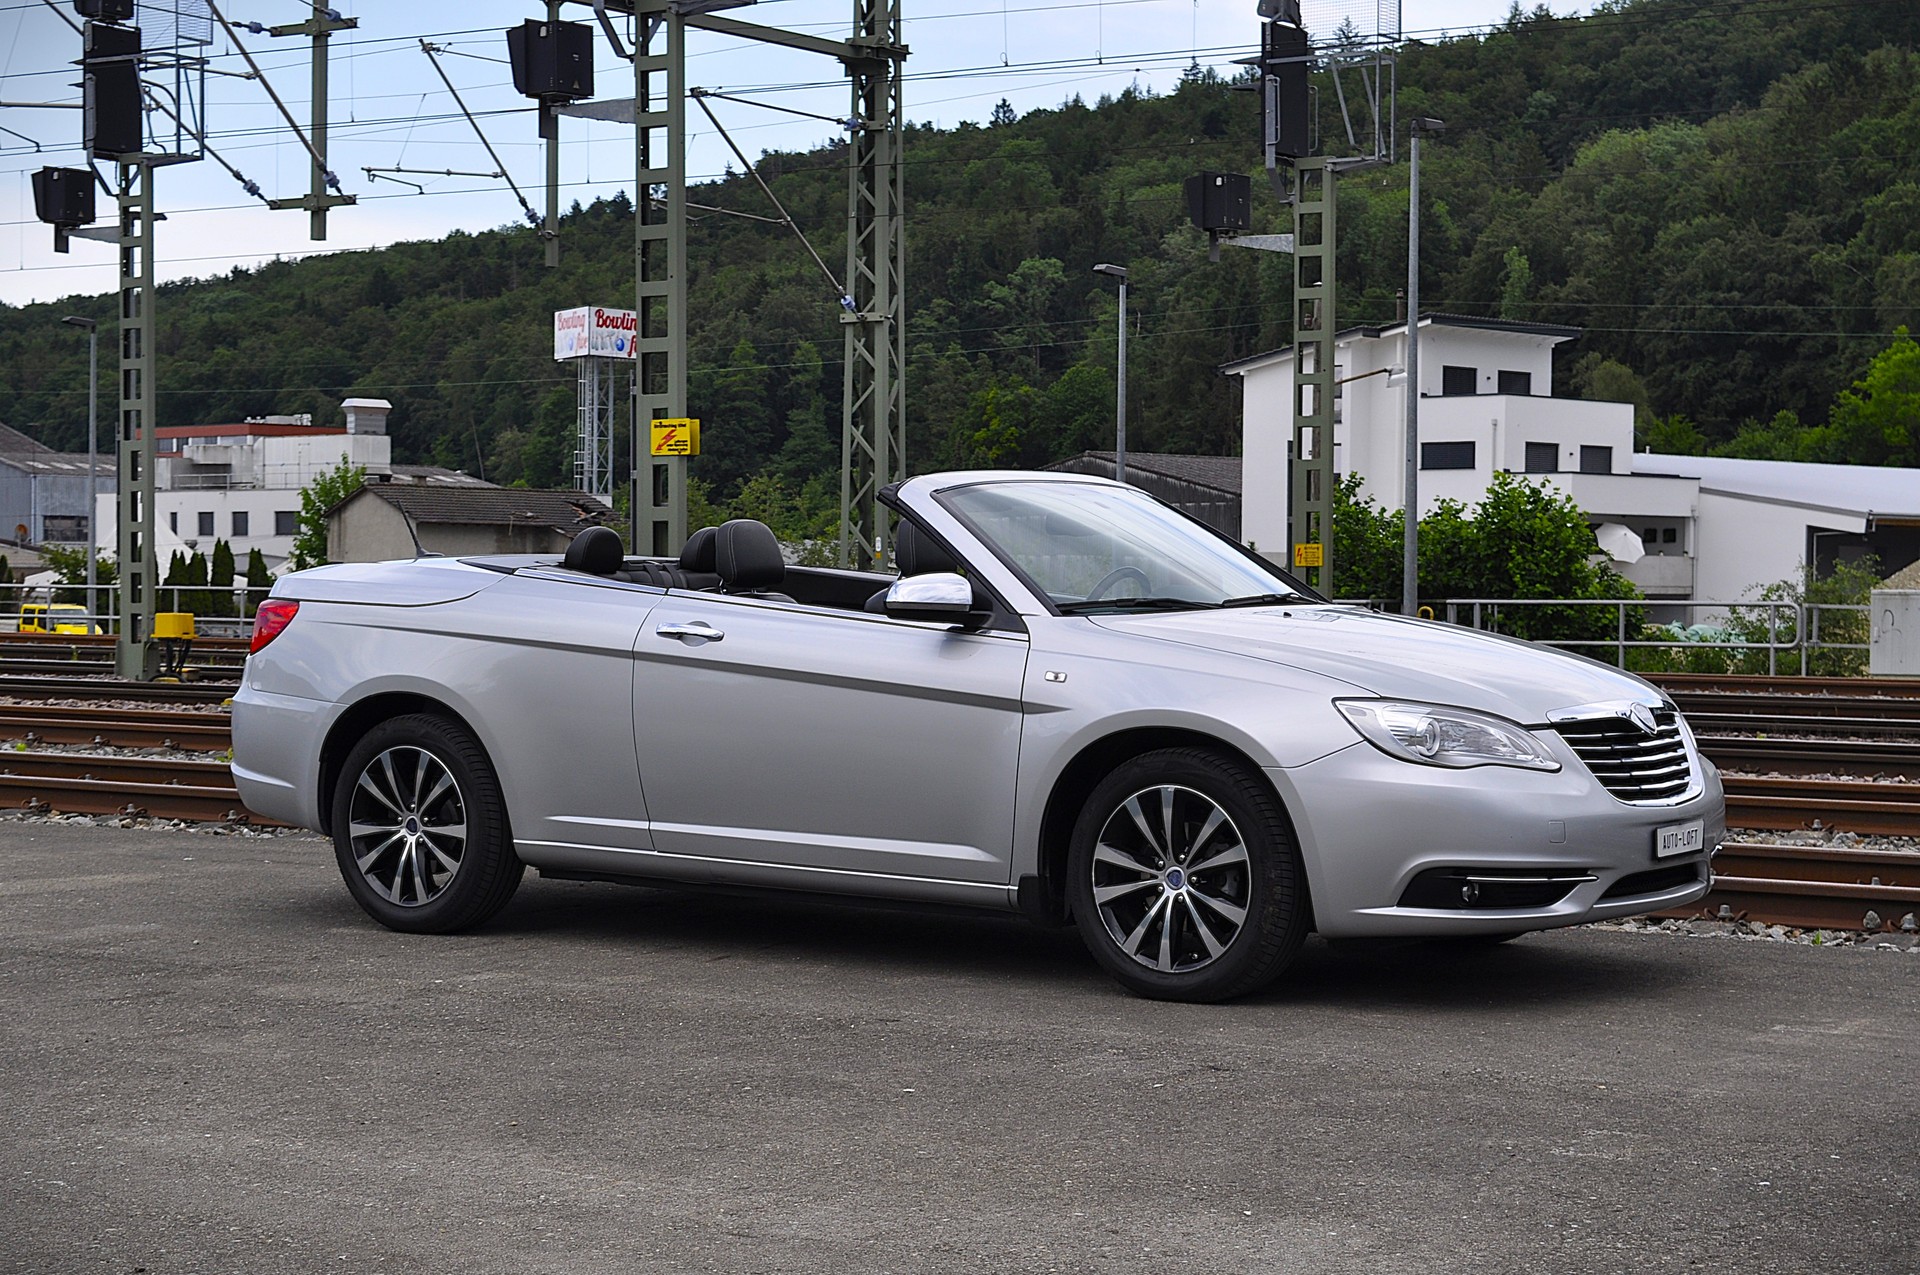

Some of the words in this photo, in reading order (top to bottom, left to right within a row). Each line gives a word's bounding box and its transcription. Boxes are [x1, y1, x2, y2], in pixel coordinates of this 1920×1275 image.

[557, 311, 586, 333] Bowling
[595, 308, 637, 331] Bowlin
[1662, 828, 1698, 850] AUTO-LOFT
